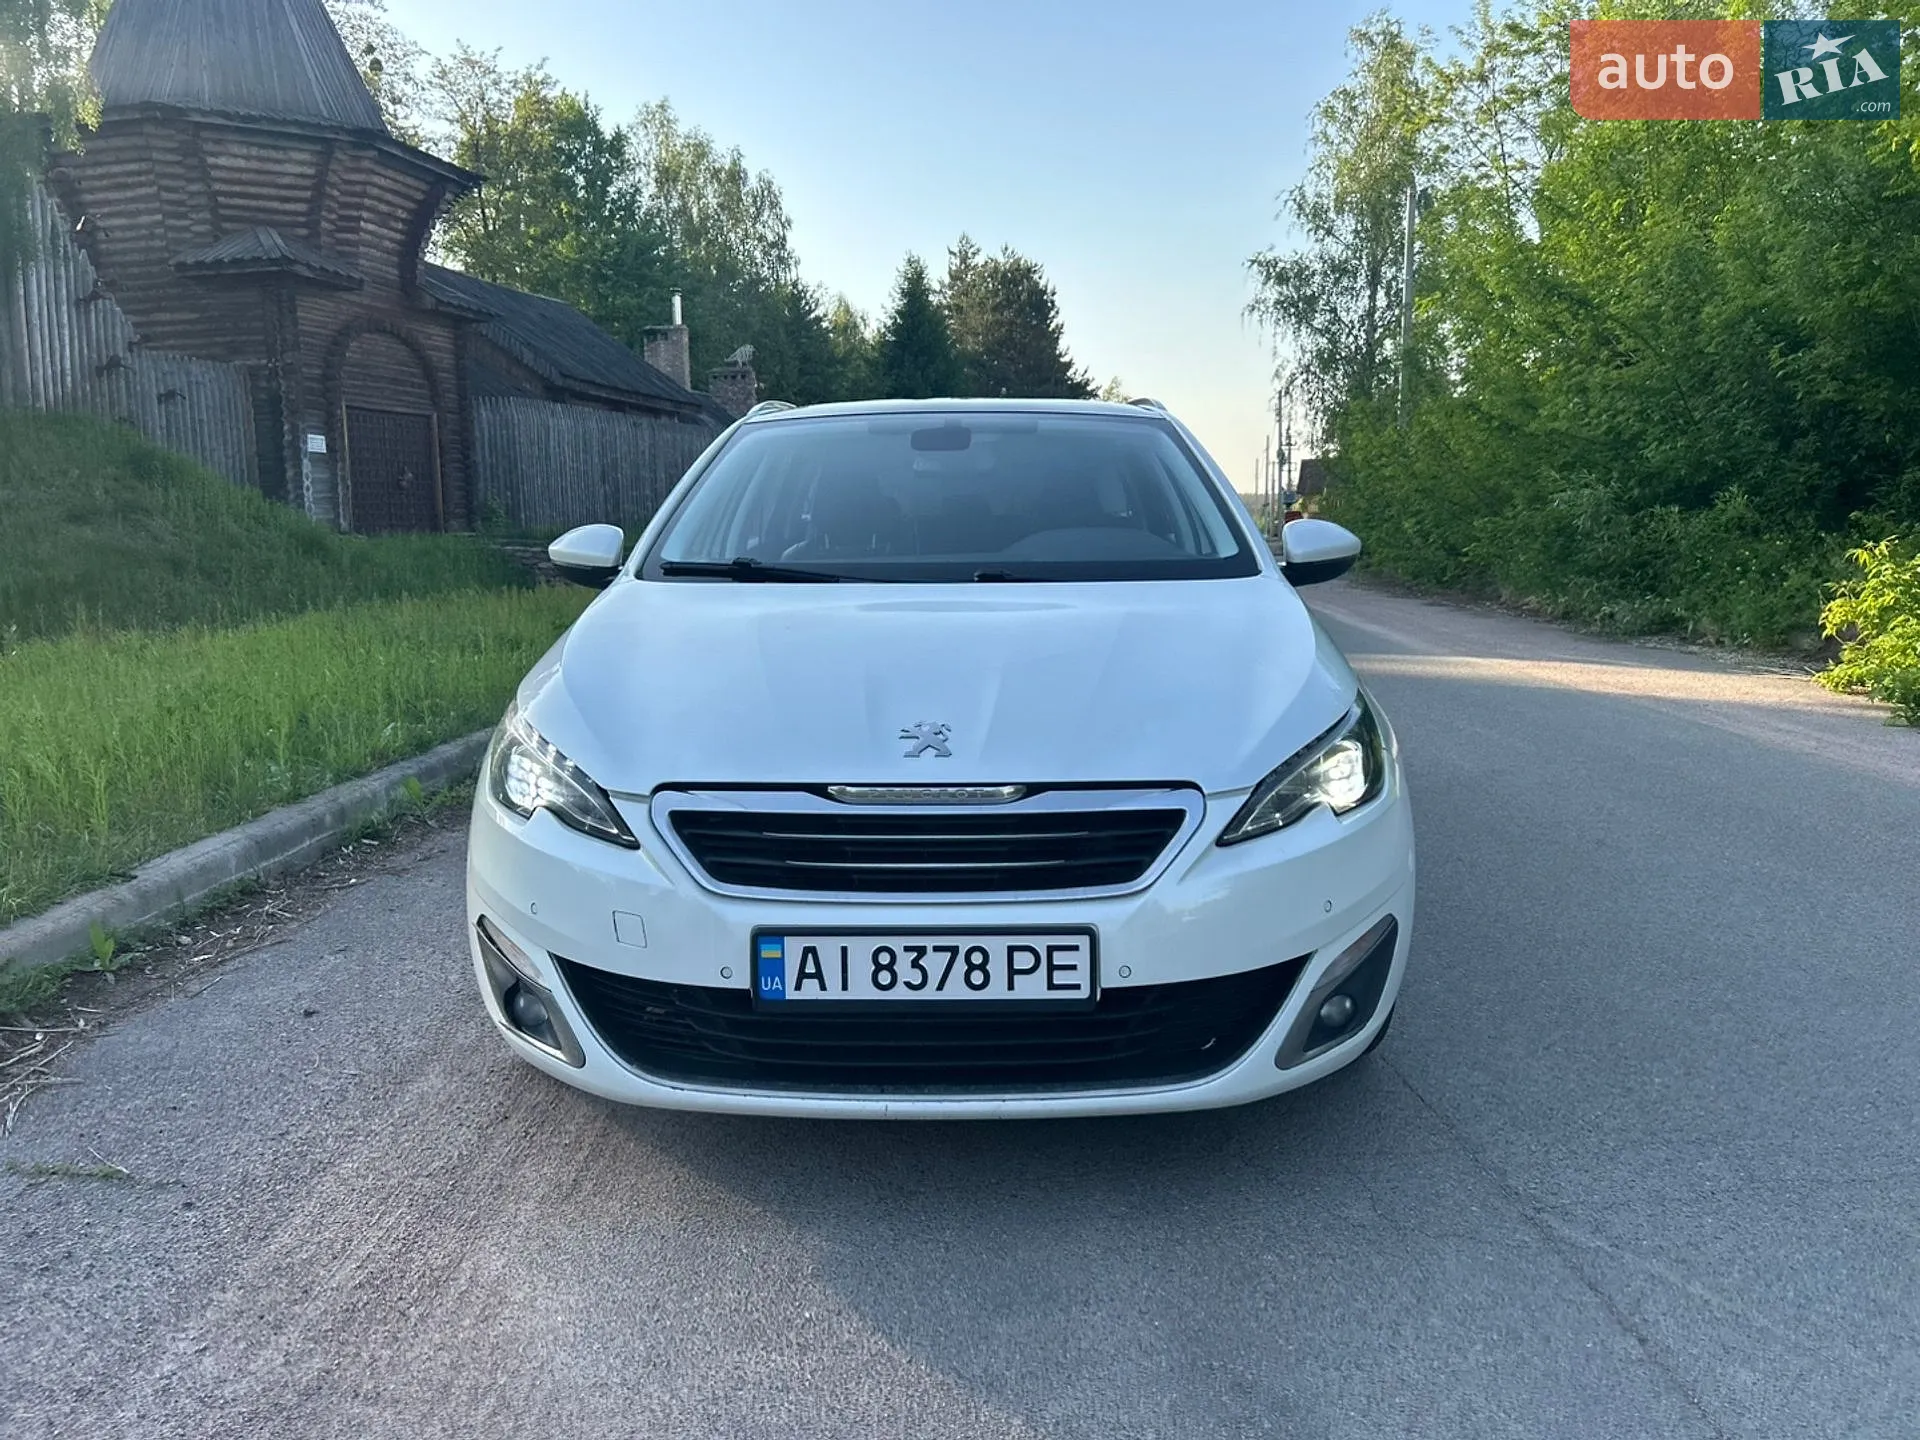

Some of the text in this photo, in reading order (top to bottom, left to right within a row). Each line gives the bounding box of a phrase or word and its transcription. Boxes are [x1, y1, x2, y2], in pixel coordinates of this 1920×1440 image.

[761, 976, 783, 991] UA
[794, 944, 1082, 992] AI 8378 PE
